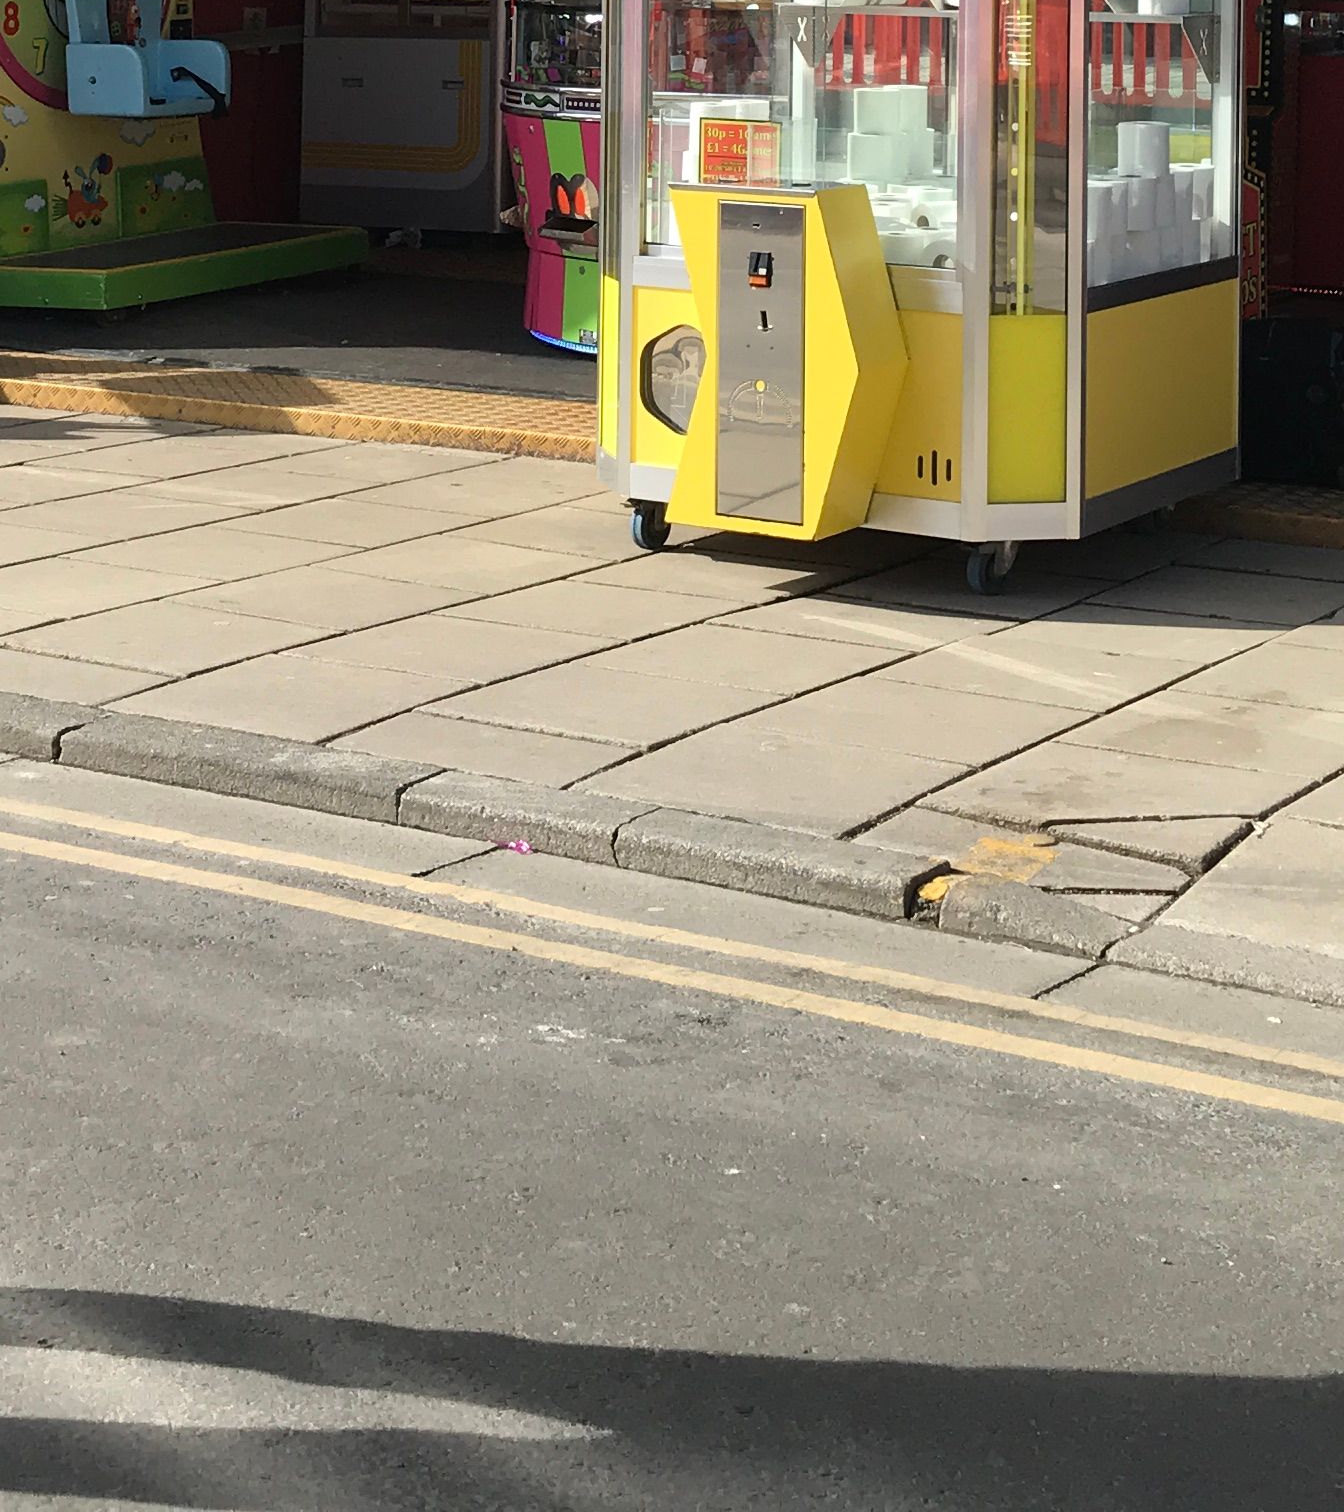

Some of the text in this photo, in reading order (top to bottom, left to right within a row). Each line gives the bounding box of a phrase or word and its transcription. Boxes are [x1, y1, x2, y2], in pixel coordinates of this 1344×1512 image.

[3, 1, 19, 36] 8
[31, 38, 49, 75] 7
[705, 127, 726, 141] 30p
[707, 142, 720, 153] £1
